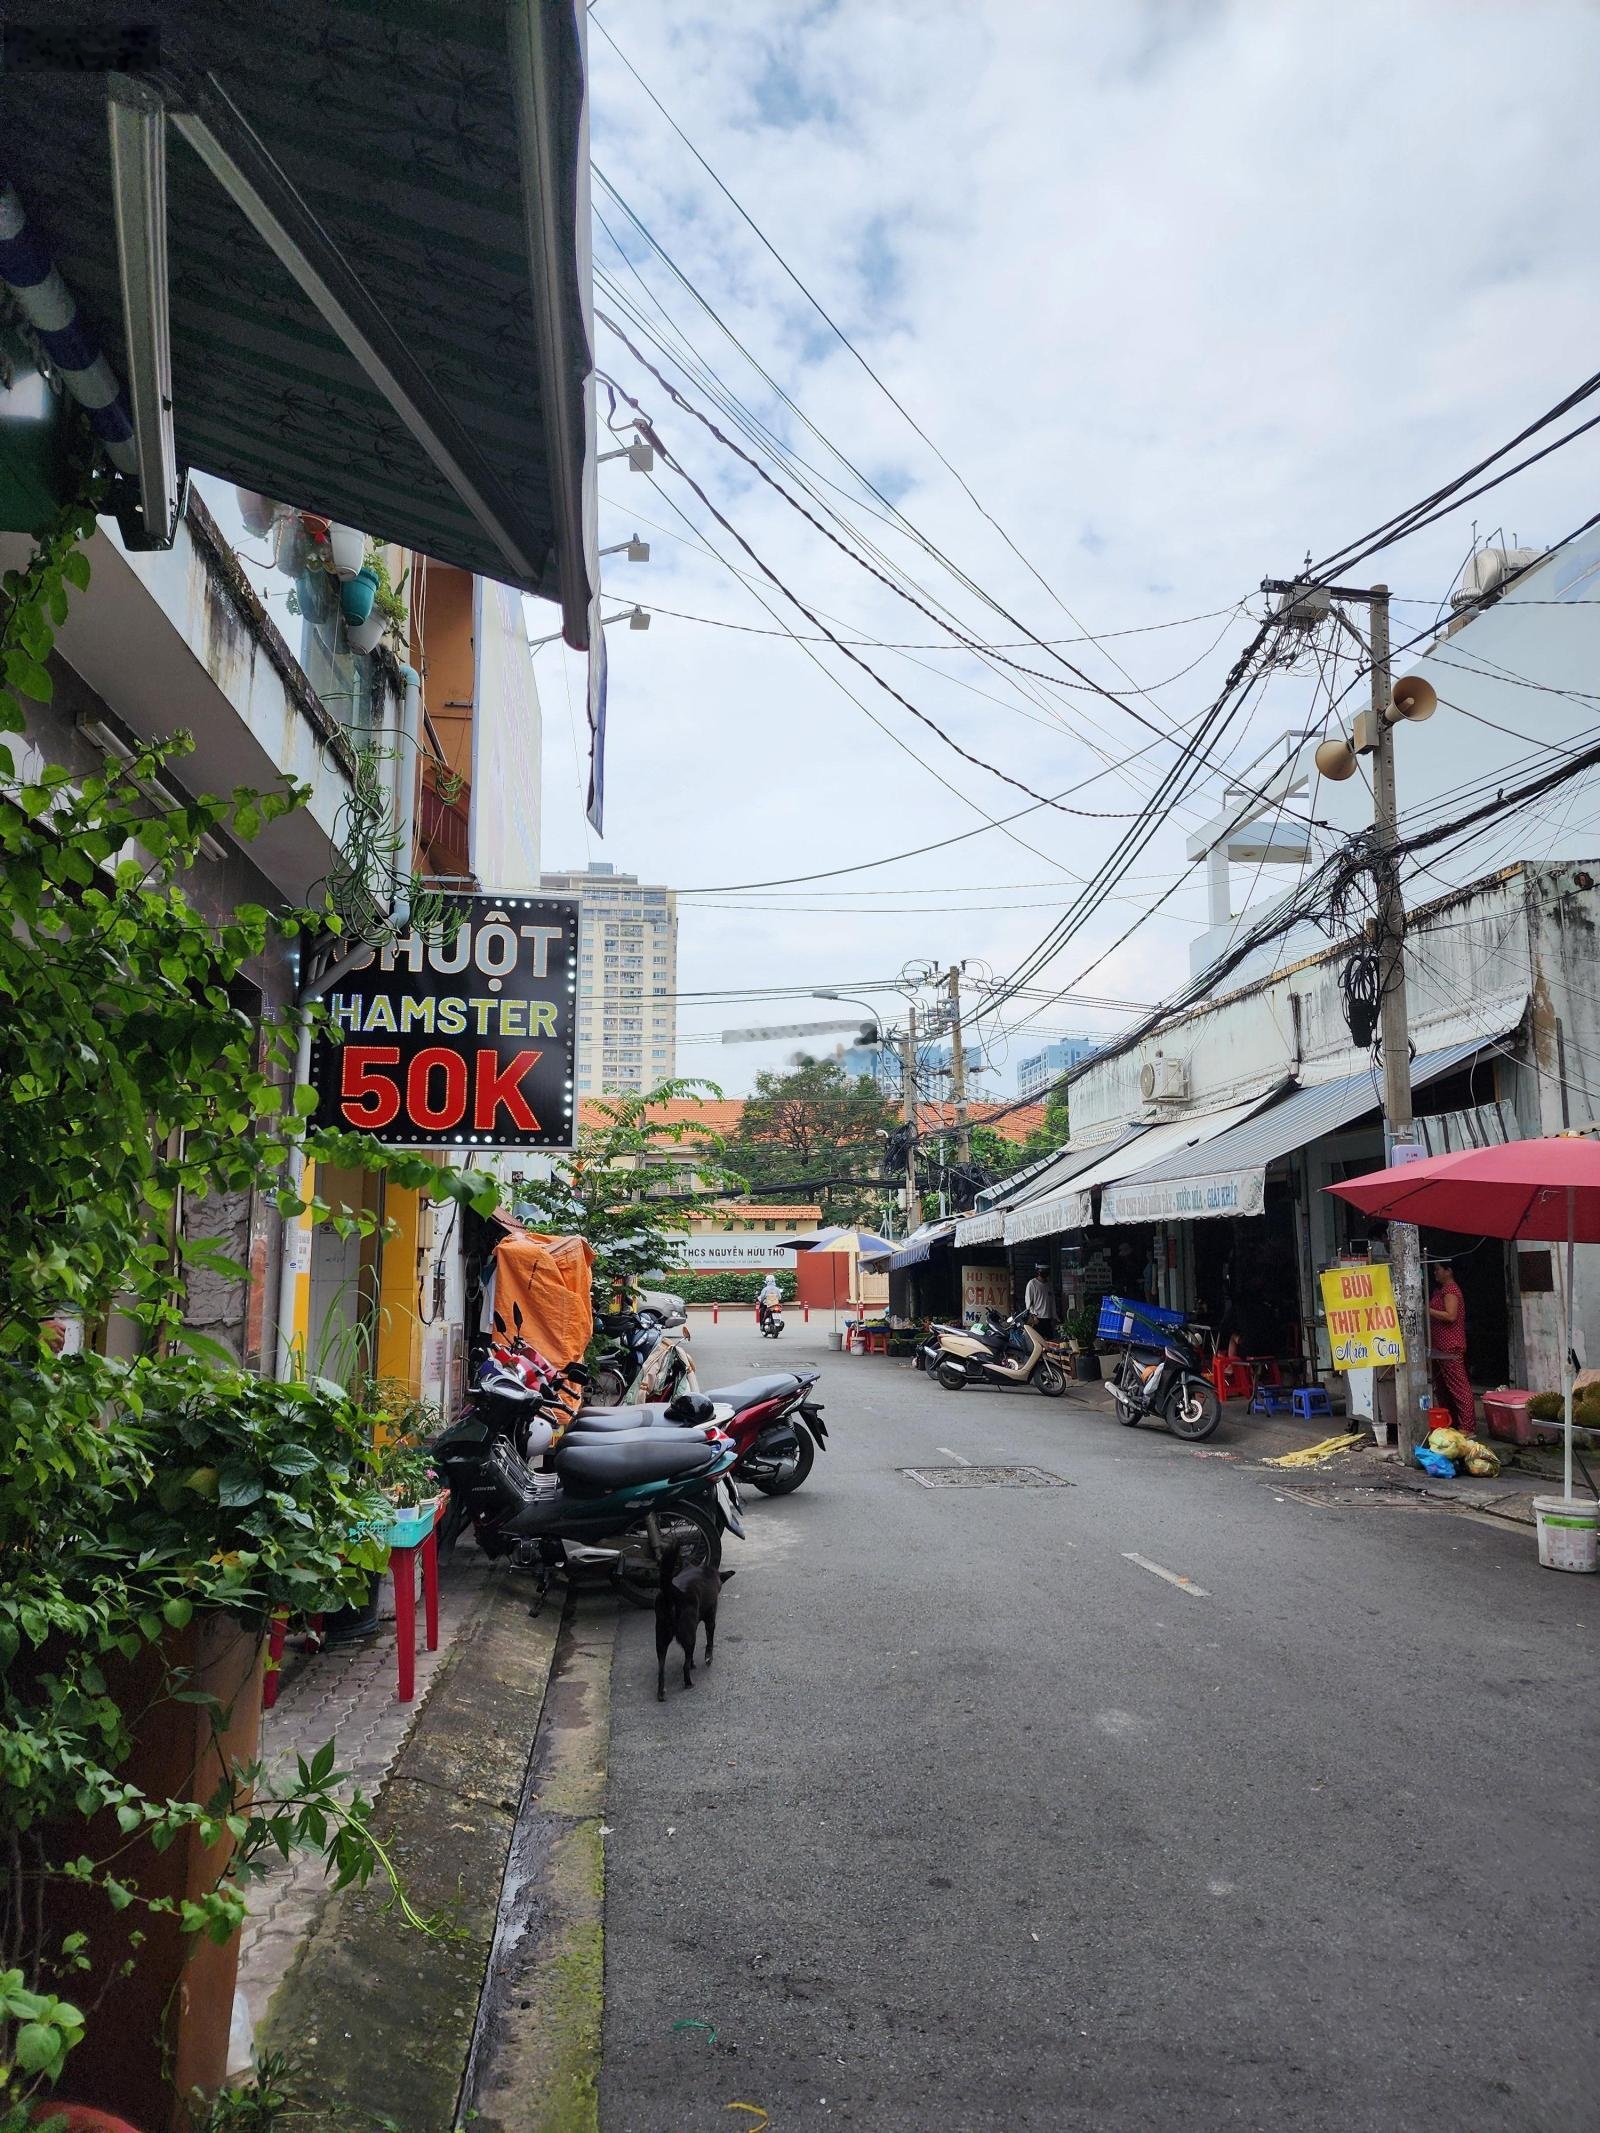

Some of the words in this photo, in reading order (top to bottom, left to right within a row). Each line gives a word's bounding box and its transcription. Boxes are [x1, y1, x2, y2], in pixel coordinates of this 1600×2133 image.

[331, 993, 558, 1038] HAMSTER
[341, 1046, 543, 1131] 50K
[683, 1248, 706, 1257] THCS
[1340, 1271, 1373, 1300] BÚN
[1329, 1309, 1361, 1338] THỊT
